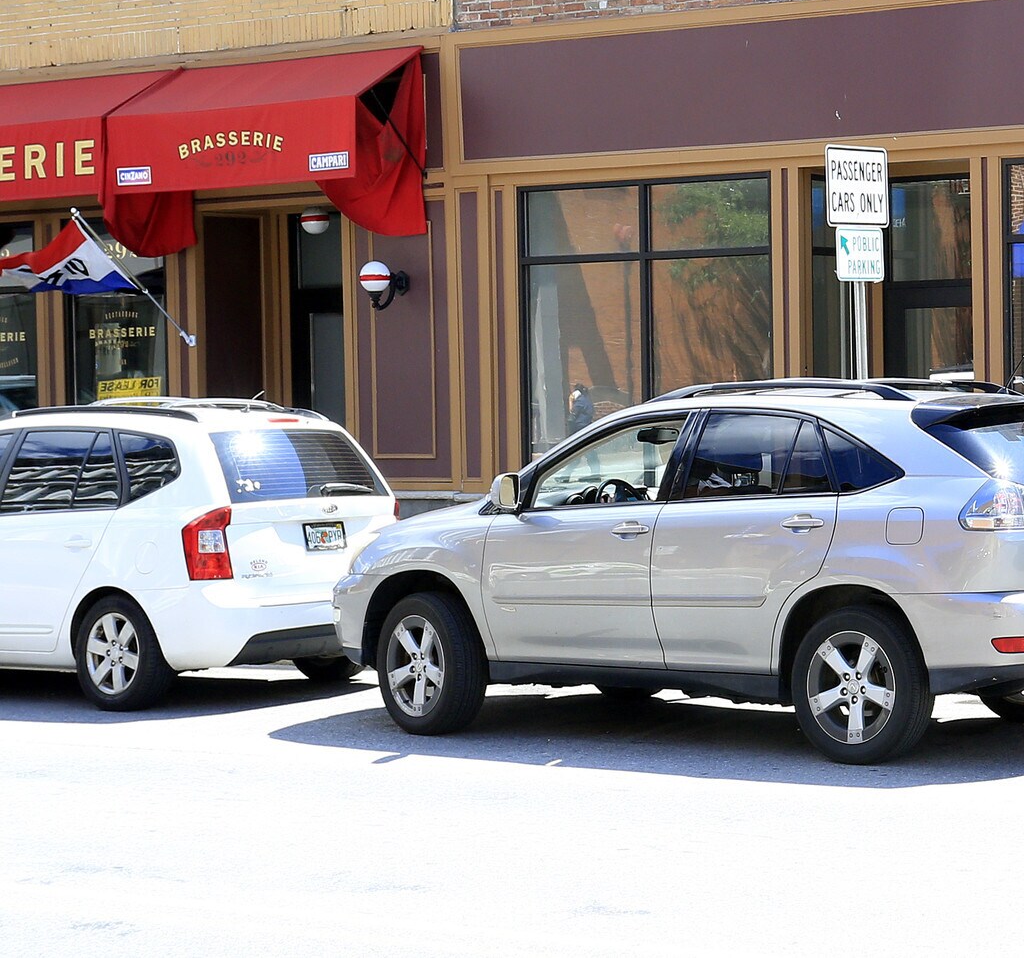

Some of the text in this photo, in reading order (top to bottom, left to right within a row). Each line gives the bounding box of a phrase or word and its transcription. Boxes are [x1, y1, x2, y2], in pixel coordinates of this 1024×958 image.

[177, 131, 284, 160] BRASSERIE
[0, 140, 95, 181] ERIE
[214, 151, 247, 167] 292
[310, 154, 348, 169] CAMPARI
[119, 171, 149, 181] CINZANO
[831, 159, 883, 182] PASSENGER
[831, 191, 884, 213] CARS ONLY
[852, 235, 880, 252] PUBLIC
[848, 259, 881, 275] PARKING
[0, 332, 26, 342] ERIE
[89, 326, 156, 339] BRASSERIE
